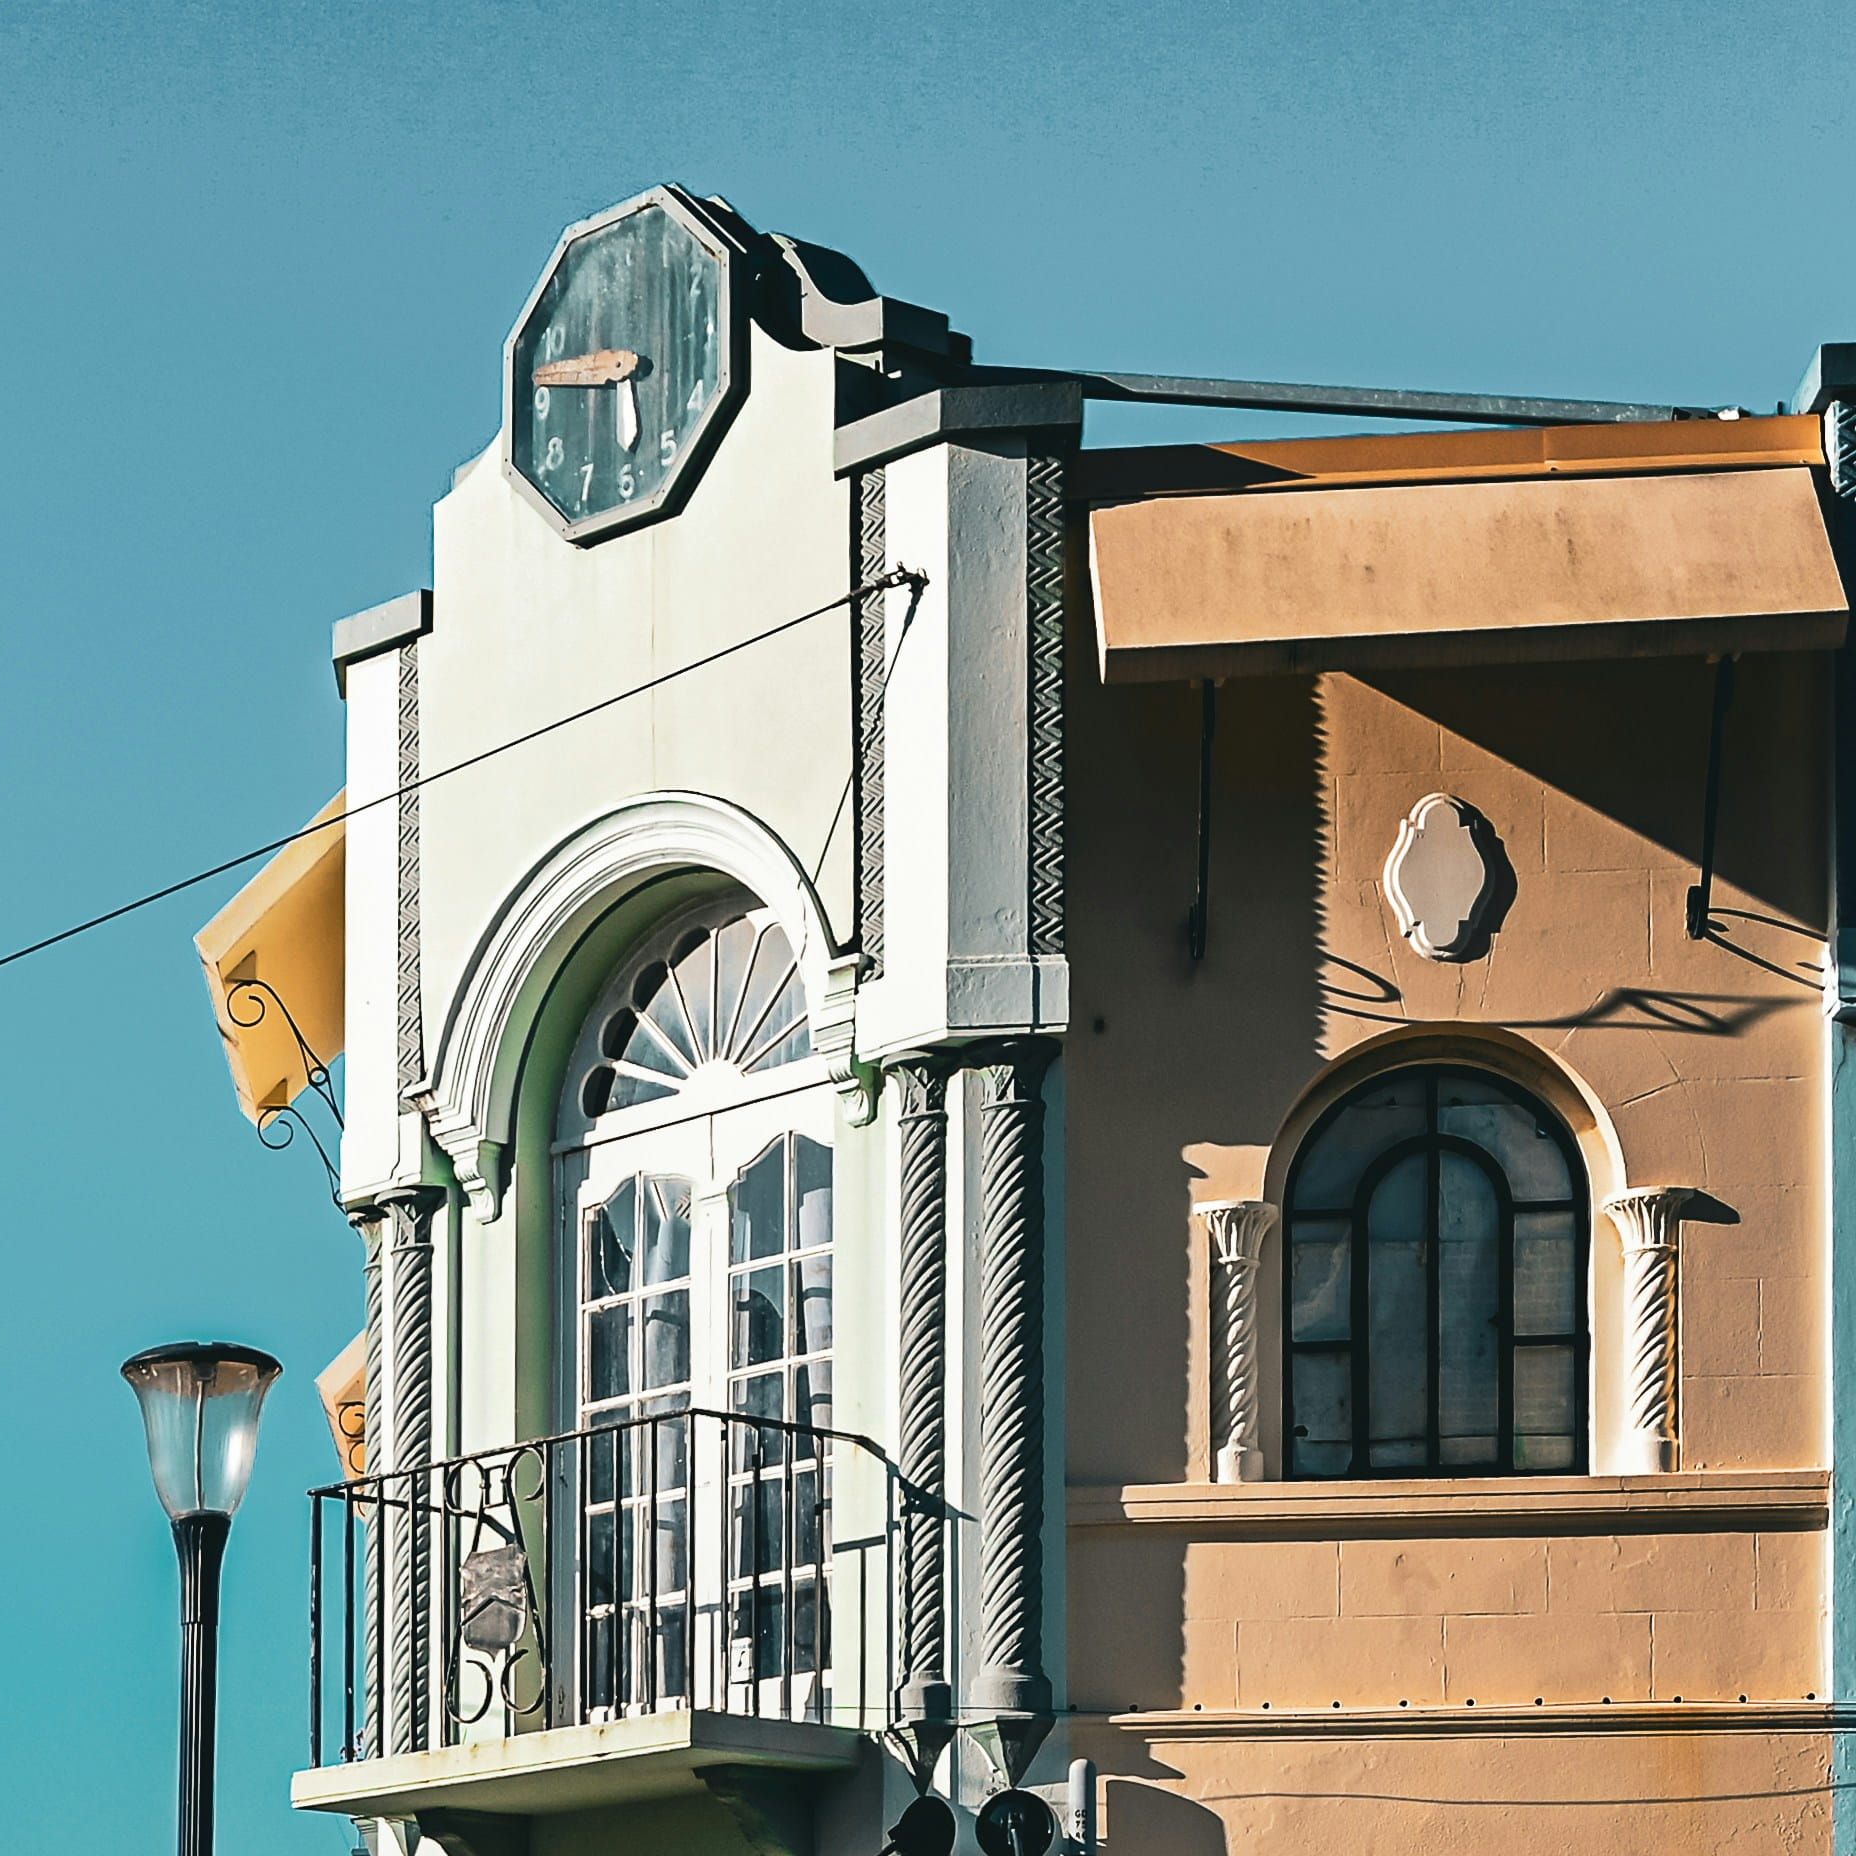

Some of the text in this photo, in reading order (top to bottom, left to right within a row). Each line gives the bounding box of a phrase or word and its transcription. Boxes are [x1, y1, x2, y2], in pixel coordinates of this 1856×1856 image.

[534, 385, 551, 421] 9
[686, 378, 705, 413] 4
[545, 436, 565, 472] 8
[660, 429, 678, 468] 5
[580, 463, 595, 502] 7
[619, 463, 636, 500] 6
